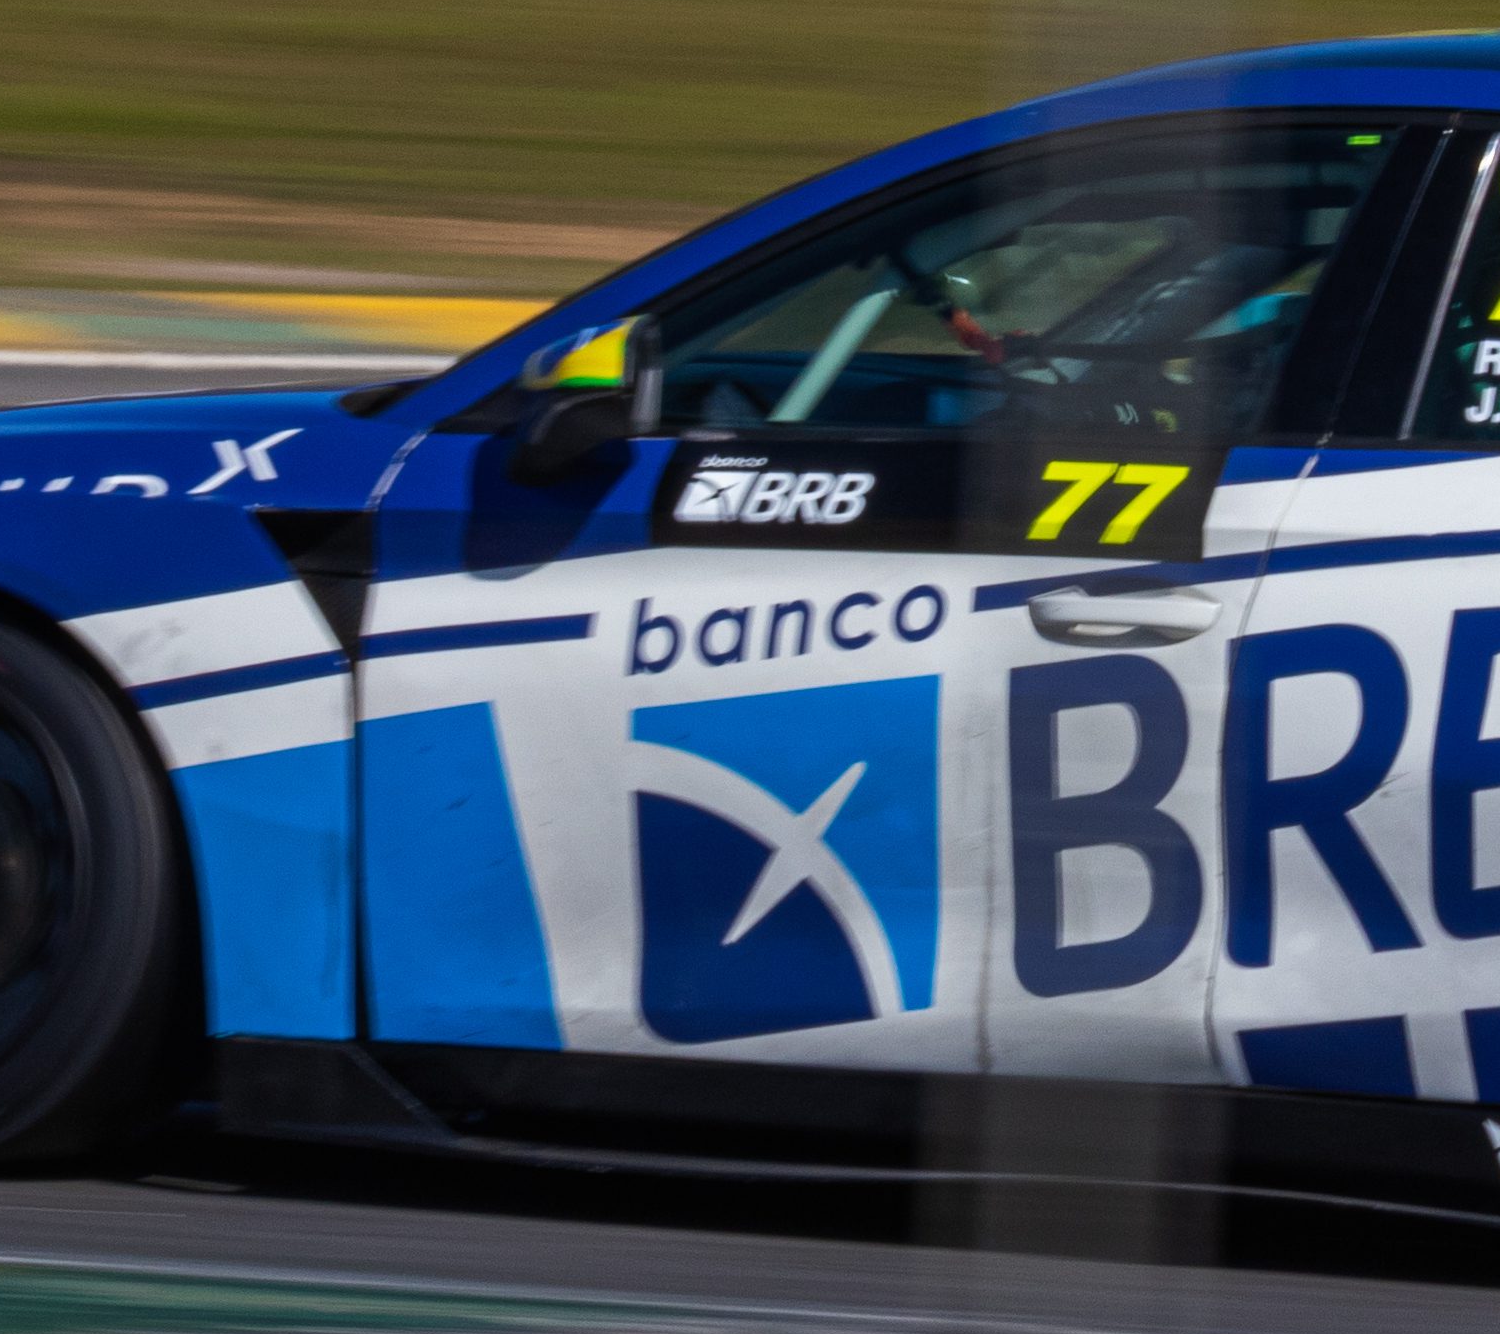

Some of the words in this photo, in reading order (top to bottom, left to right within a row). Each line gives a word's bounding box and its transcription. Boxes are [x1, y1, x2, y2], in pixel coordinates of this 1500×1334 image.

[739, 471, 876, 524] BRB
[1025, 461, 1191, 544] 77
[627, 583, 947, 676] banco
